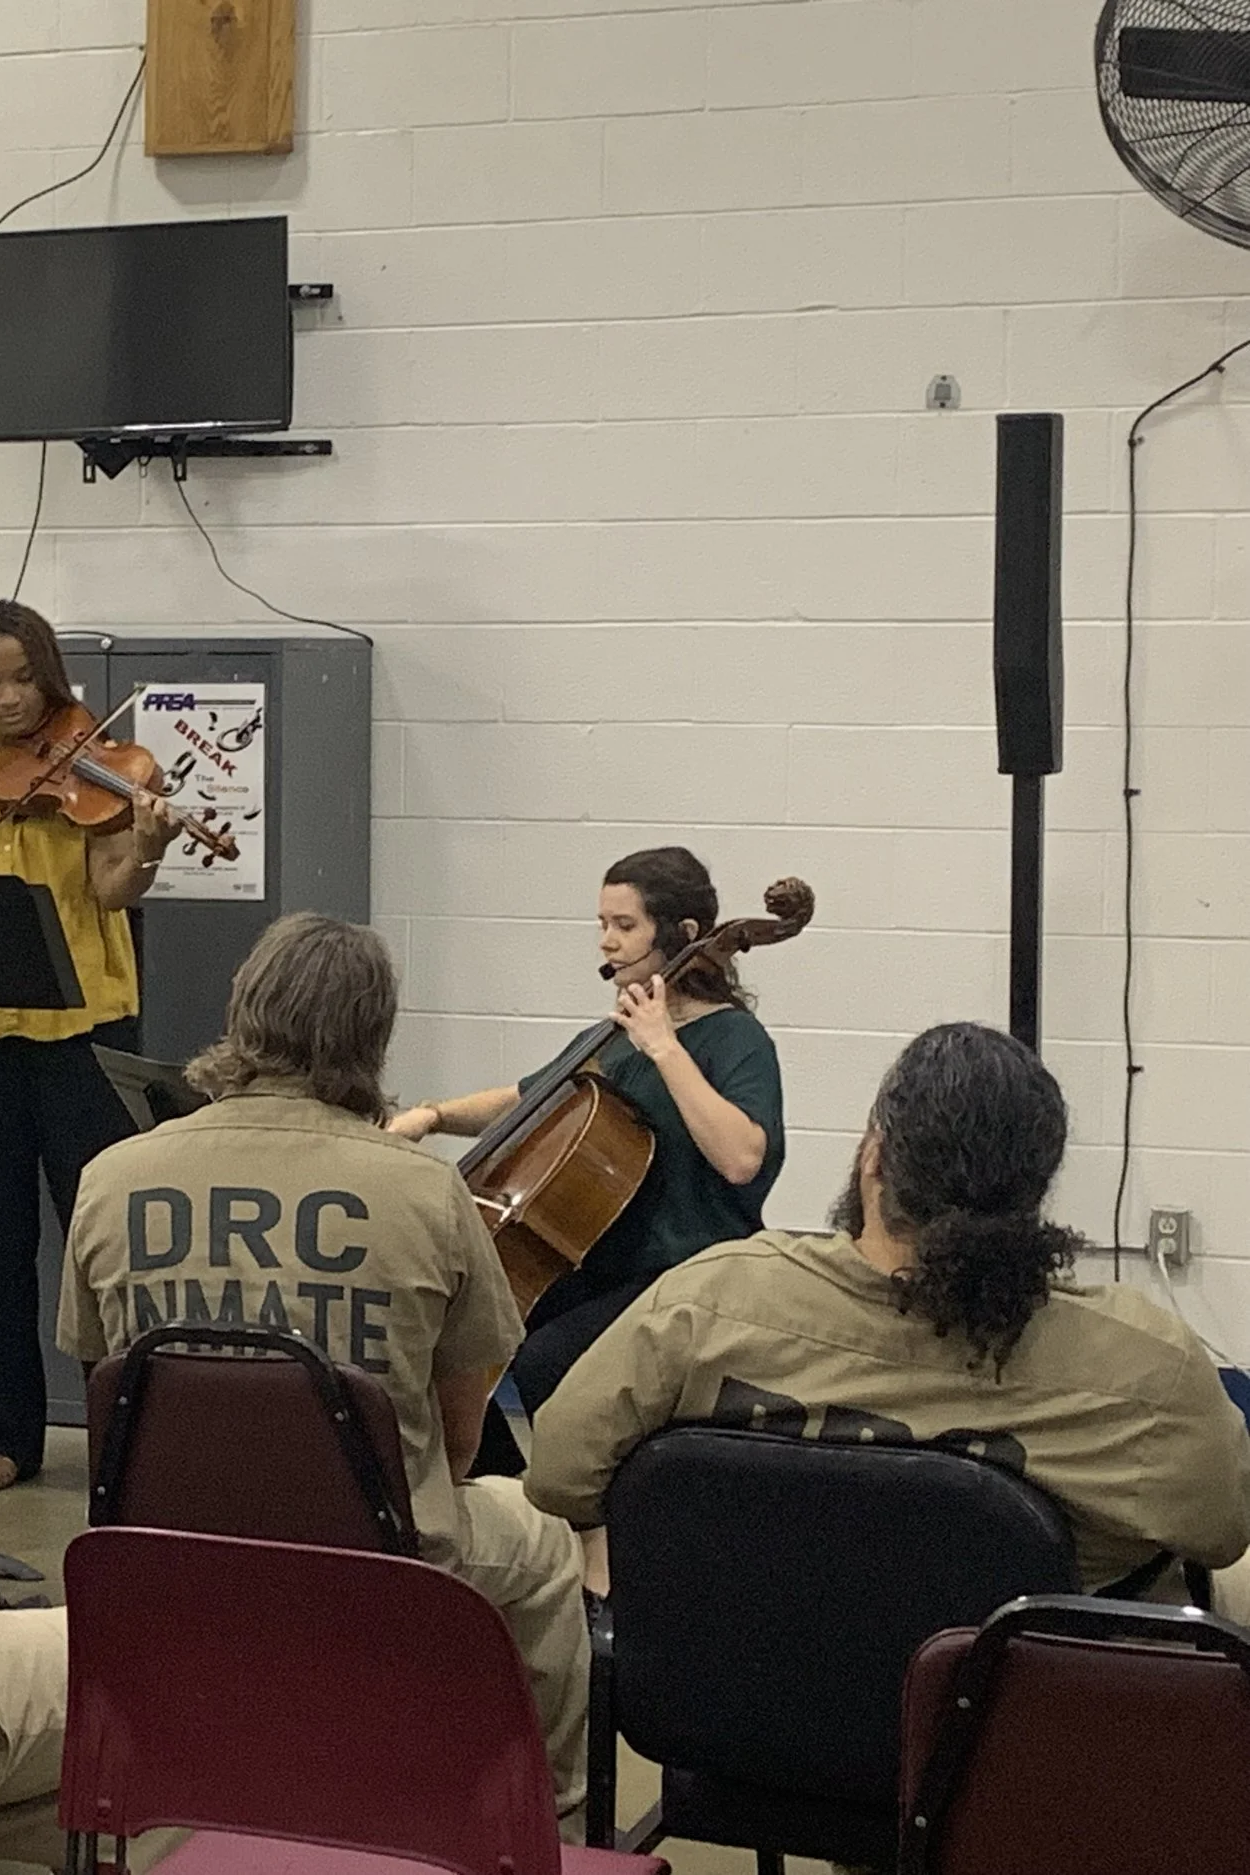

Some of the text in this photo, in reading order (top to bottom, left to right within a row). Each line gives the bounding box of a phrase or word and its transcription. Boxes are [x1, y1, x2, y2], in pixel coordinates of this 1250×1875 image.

[142, 692, 197, 711] PREA
[174, 718, 238, 778] BREAK
[194, 774, 215, 782] The
[127, 1187, 369, 1273] DRC
